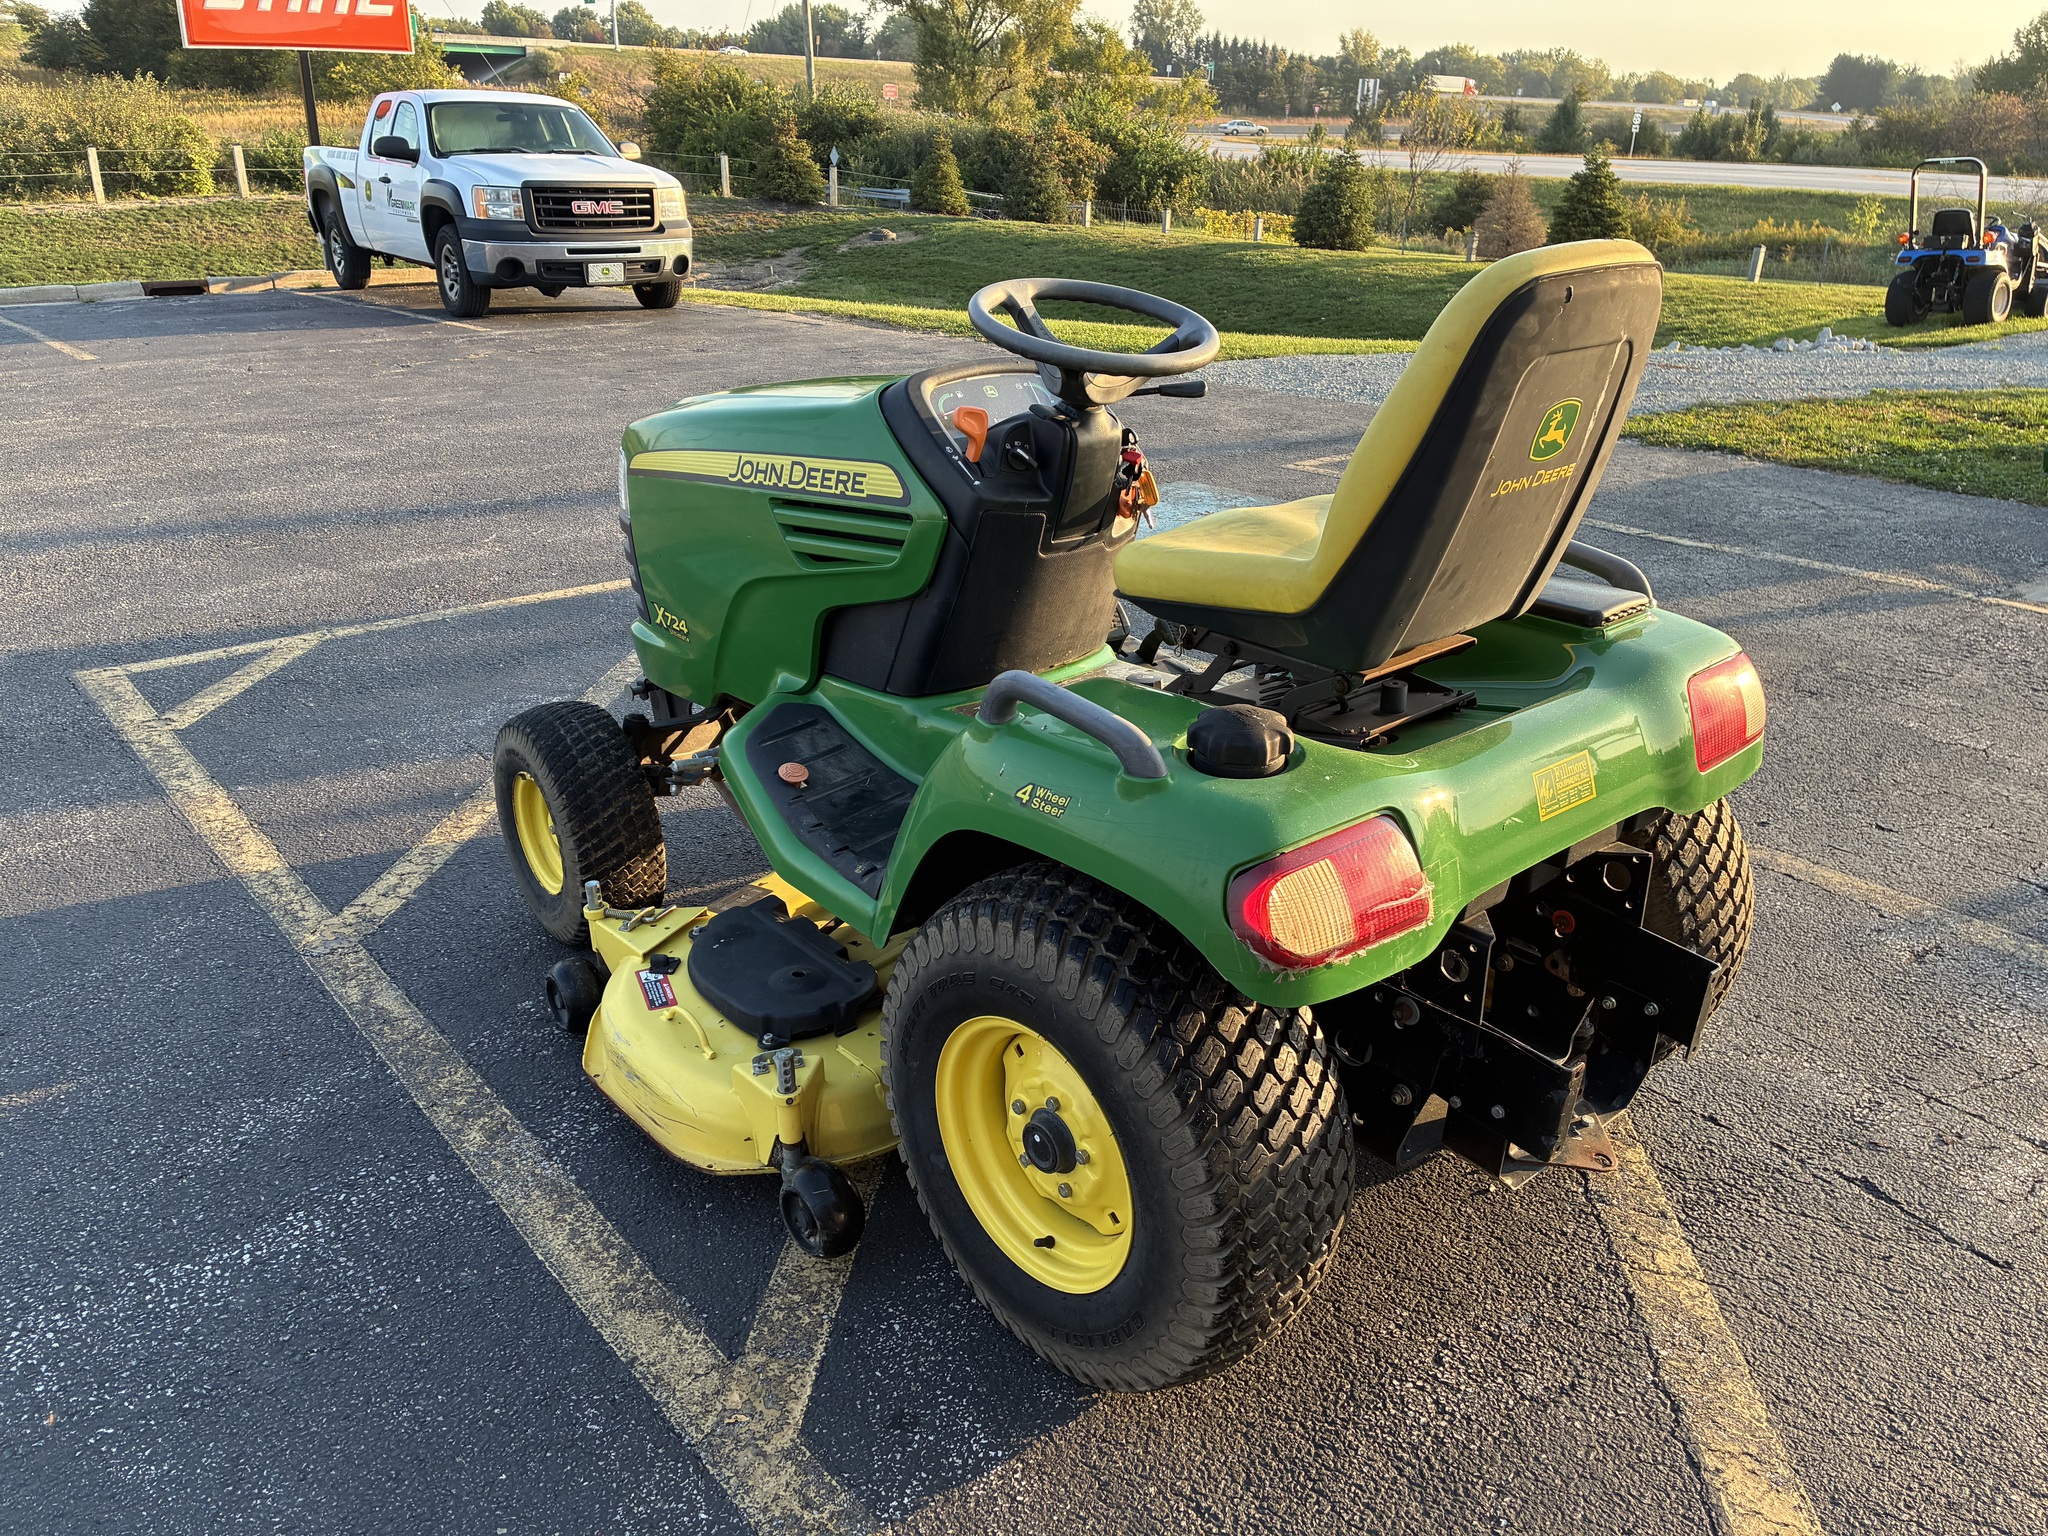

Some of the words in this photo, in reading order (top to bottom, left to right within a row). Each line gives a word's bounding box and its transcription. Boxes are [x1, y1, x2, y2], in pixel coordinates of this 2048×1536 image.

[571, 201, 624, 214] GMC
[728, 455, 785, 484] JOHN
[787, 460, 867, 494] DEERE
[1490, 475, 1533, 498] JOHN
[1532, 463, 1576, 487] DEERE
[653, 602, 689, 634] X724
[1554, 760, 1588, 781] Fillmore
[1016, 784, 1034, 804] 4
[1036, 786, 1070, 807] Wheel
[1031, 797, 1064, 817] Steer
